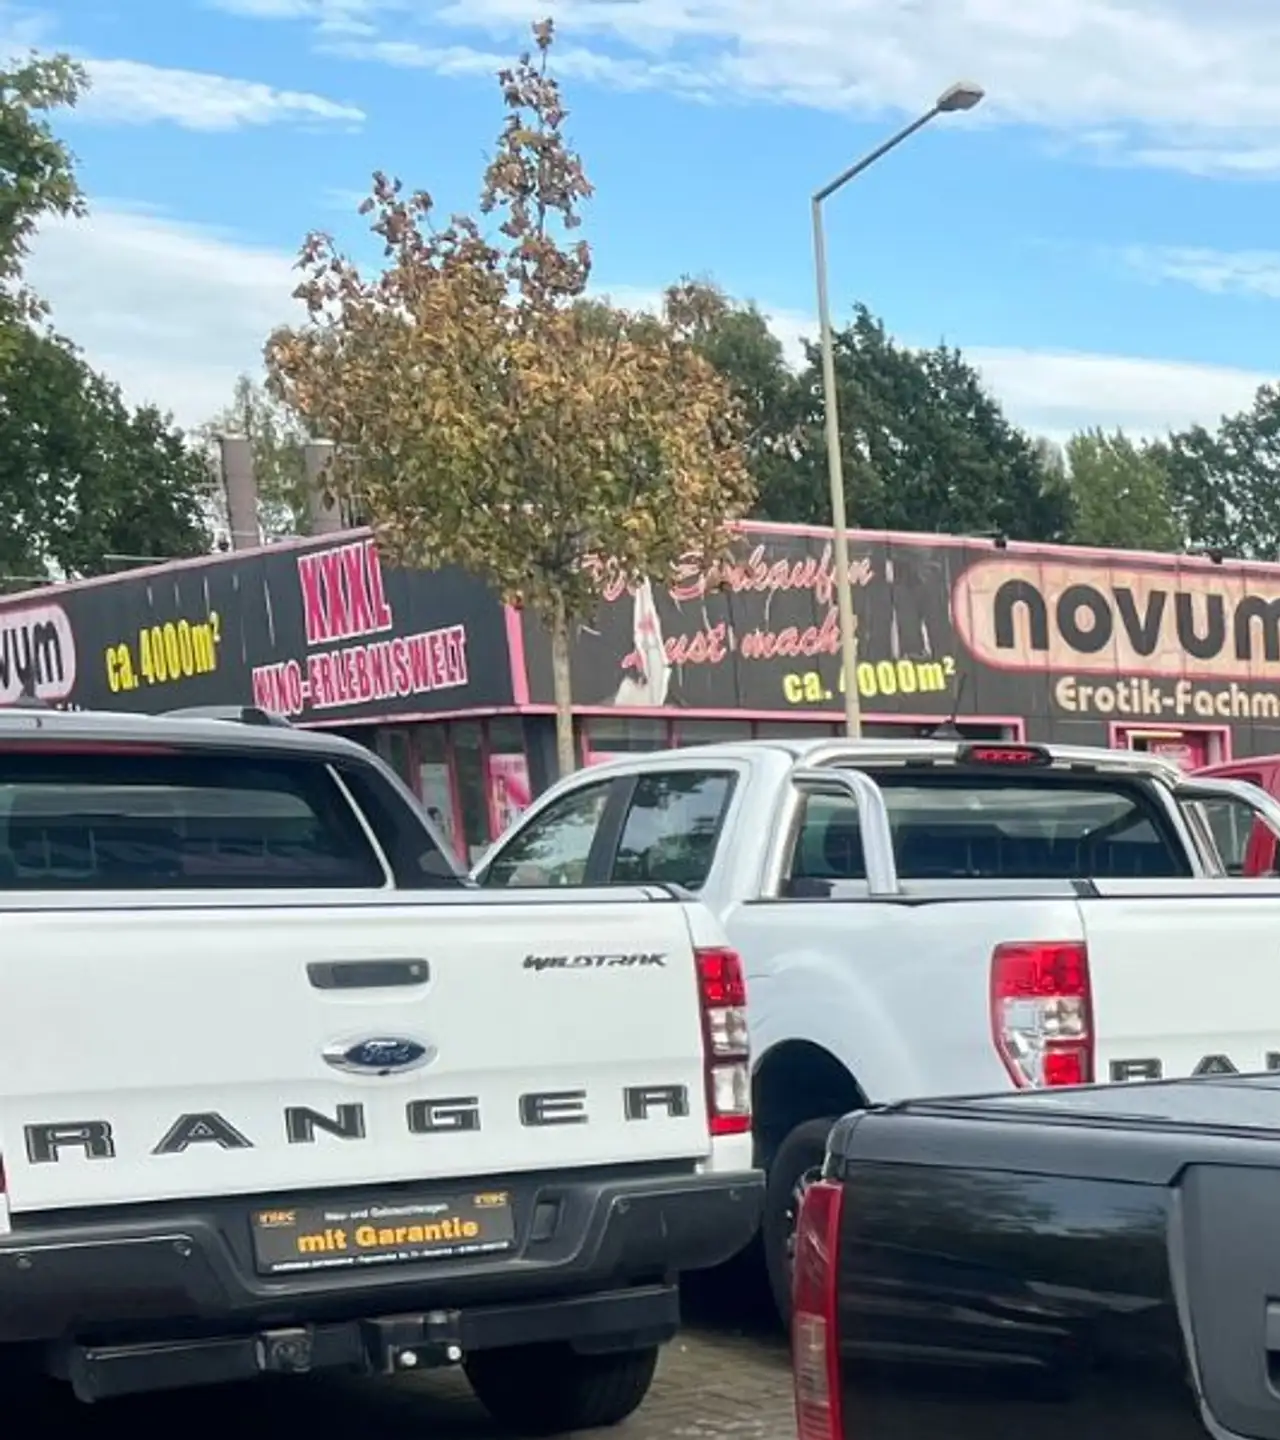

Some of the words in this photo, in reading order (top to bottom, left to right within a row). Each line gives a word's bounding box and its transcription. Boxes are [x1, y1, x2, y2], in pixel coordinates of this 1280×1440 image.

[298, 541, 392, 645] XXXL
[106, 643, 139, 693] ca.
[139, 610, 221, 685] 4000m²
[740, 605, 858, 660] mach
[783, 671, 833, 703] ca.
[24, 1083, 691, 1163] RANGER
[297, 1228, 348, 1252] mit
[355, 1217, 480, 1247] Garantie
